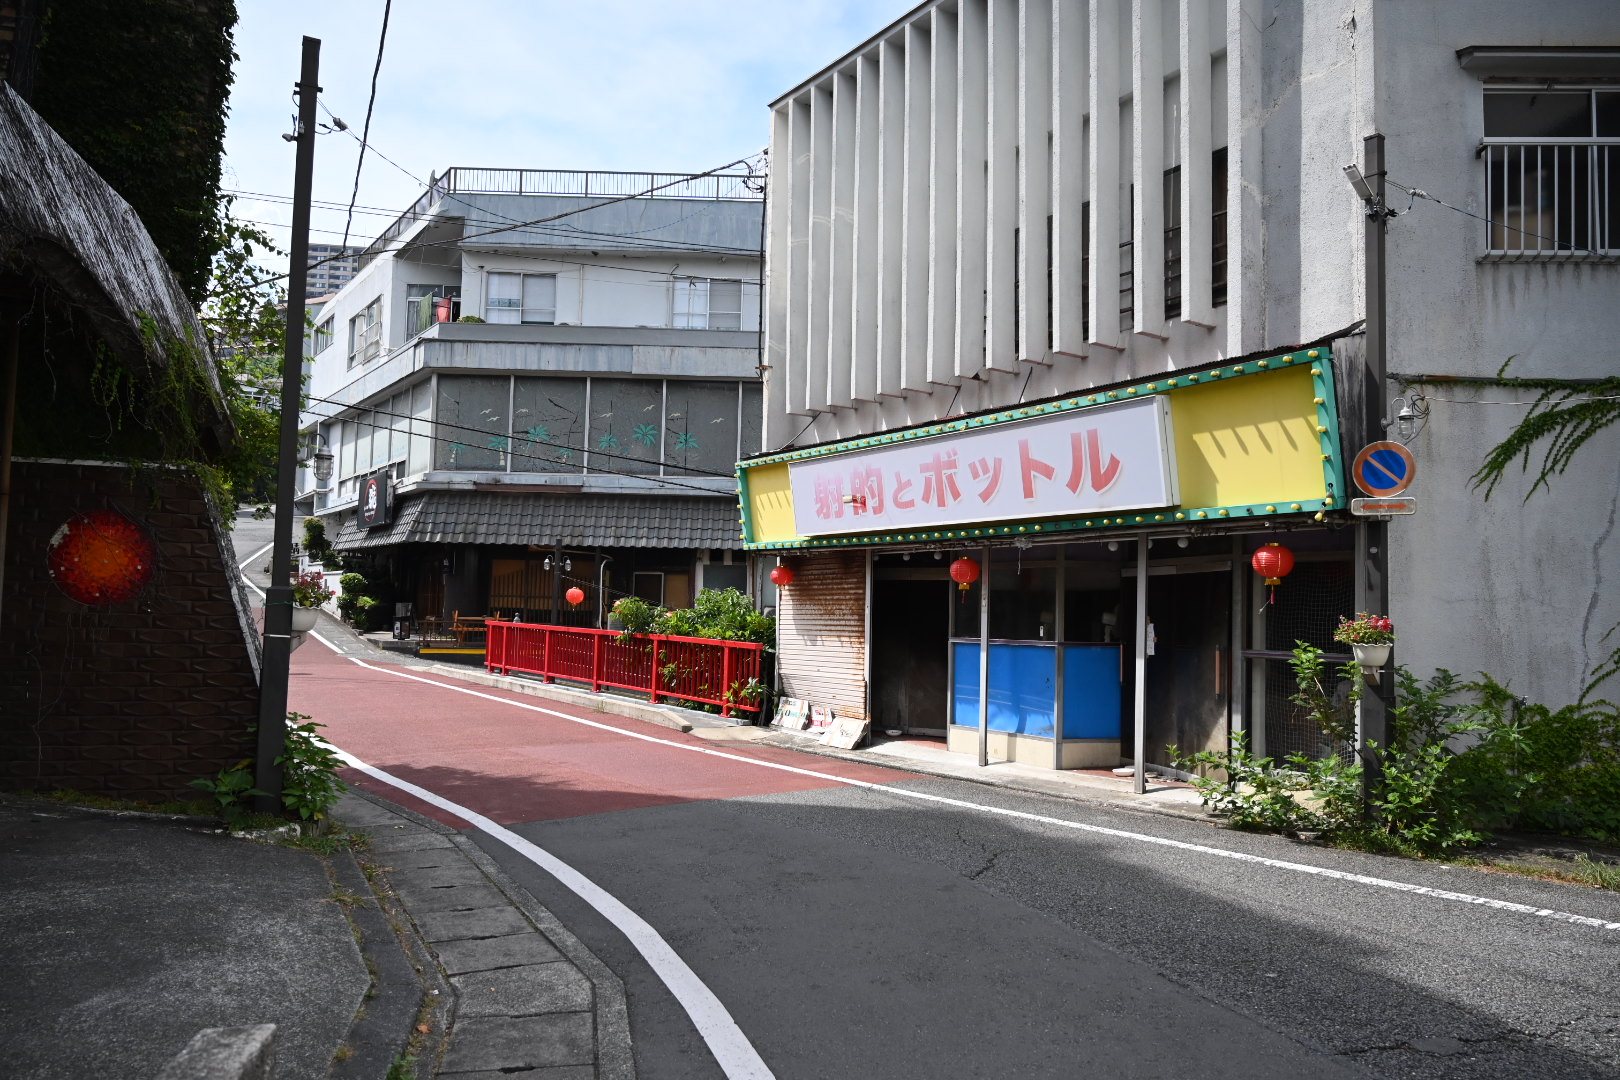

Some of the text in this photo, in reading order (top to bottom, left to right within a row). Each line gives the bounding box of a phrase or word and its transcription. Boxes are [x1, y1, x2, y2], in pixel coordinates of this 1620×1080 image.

[813, 428, 1122, 520] 射的とボットル
